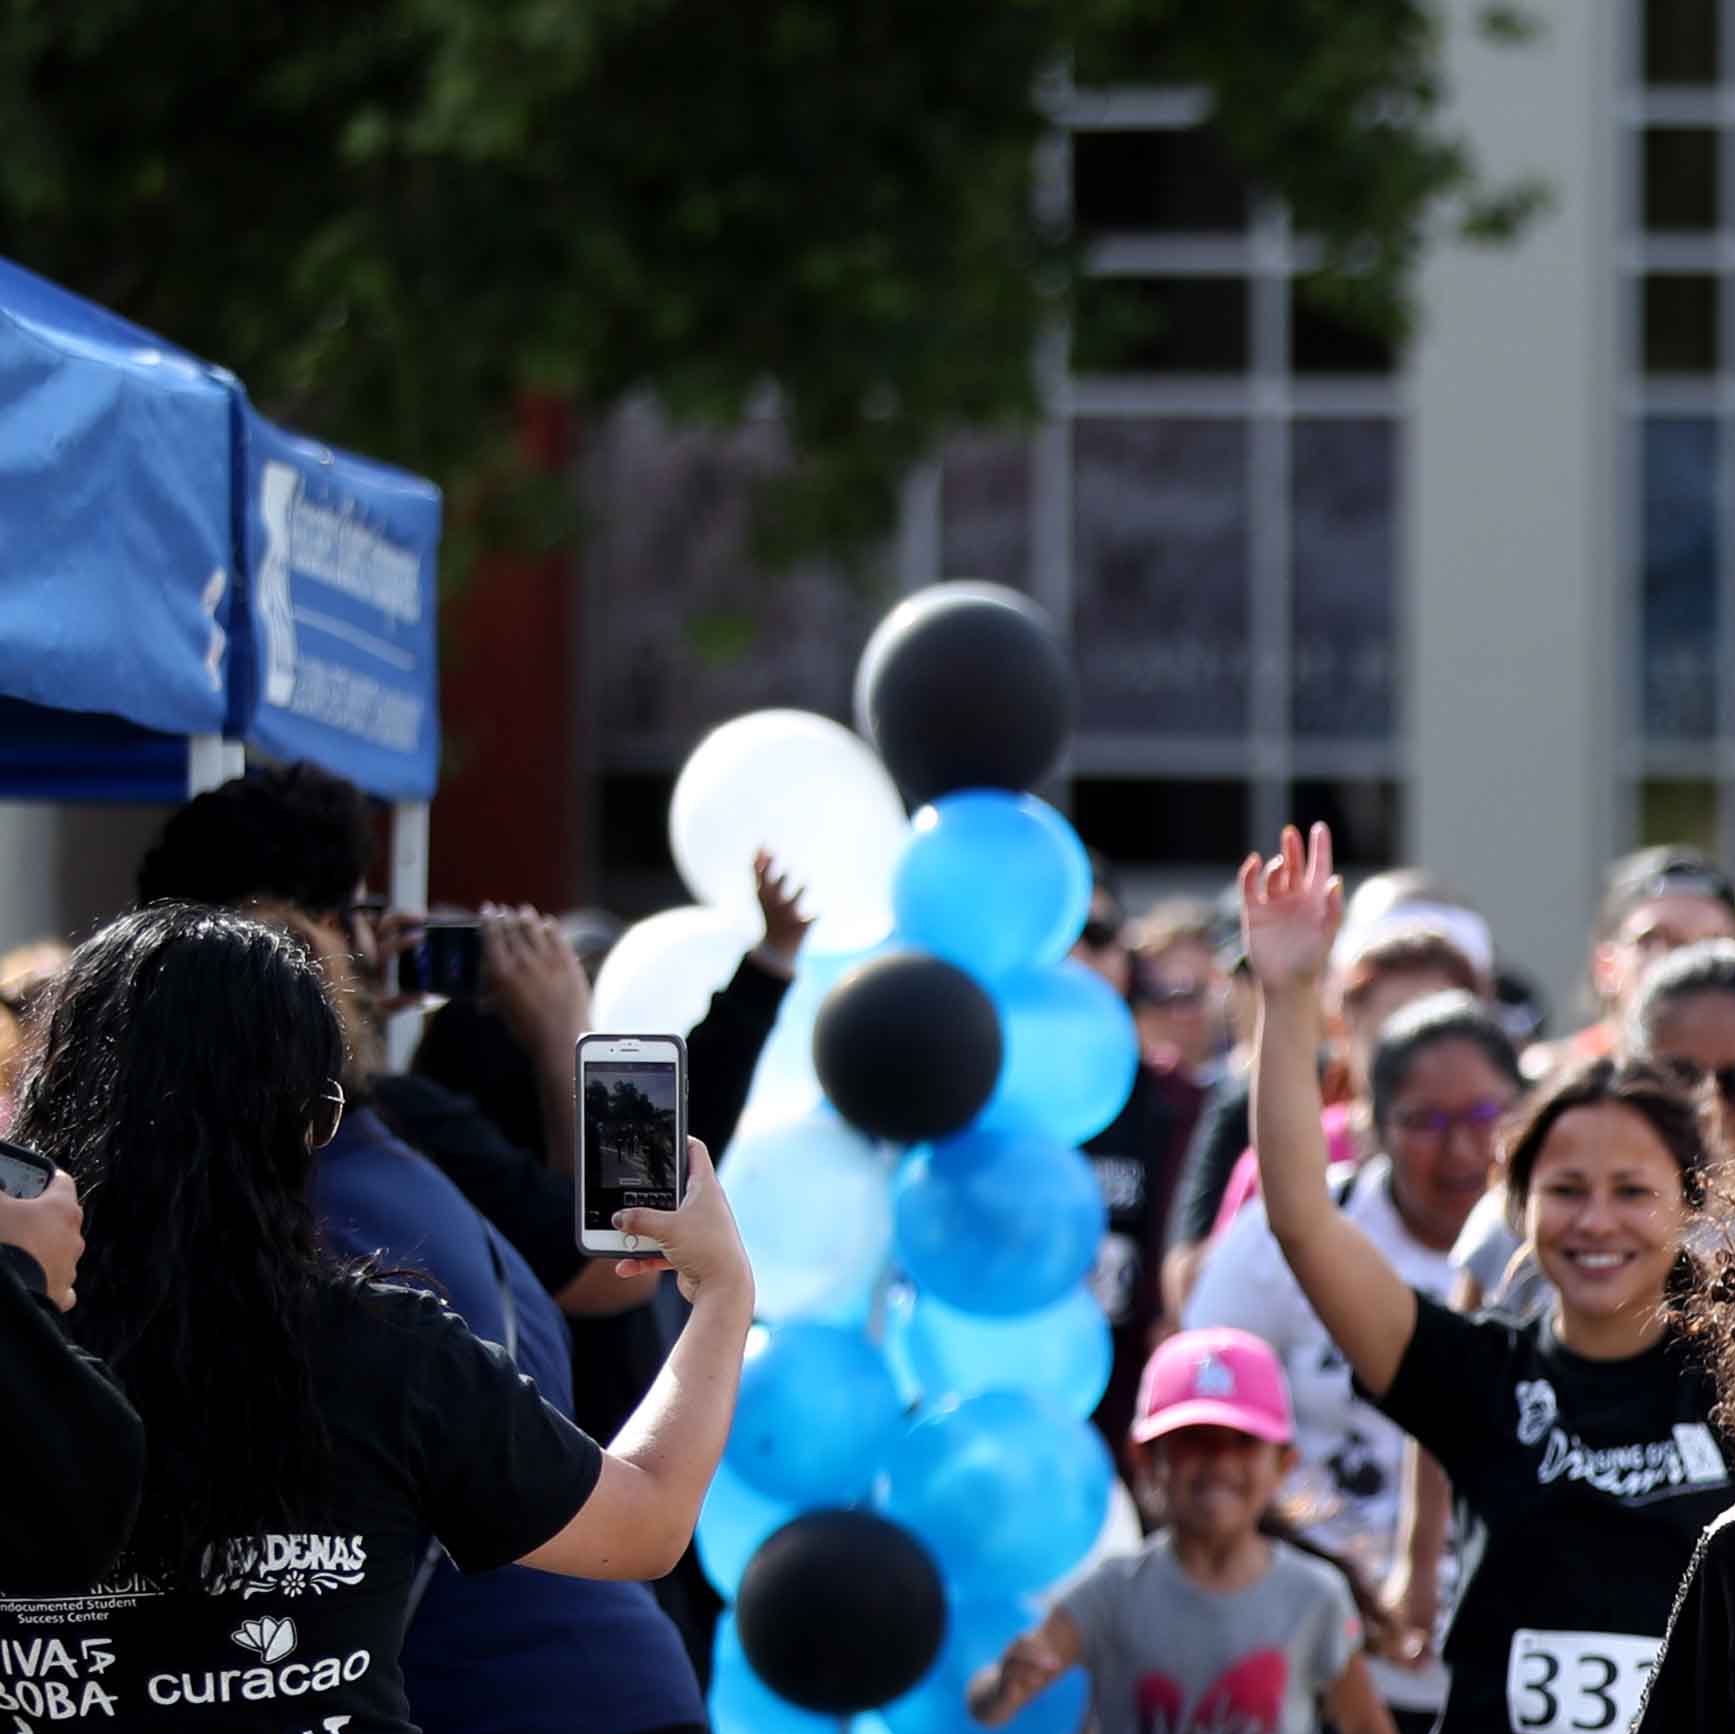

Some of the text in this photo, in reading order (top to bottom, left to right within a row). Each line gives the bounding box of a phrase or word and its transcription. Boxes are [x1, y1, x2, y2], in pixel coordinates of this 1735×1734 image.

[86, 1597, 137, 1609] Student
[17, 1611, 110, 1624] Success Center
[148, 1650, 371, 1705] curacao
